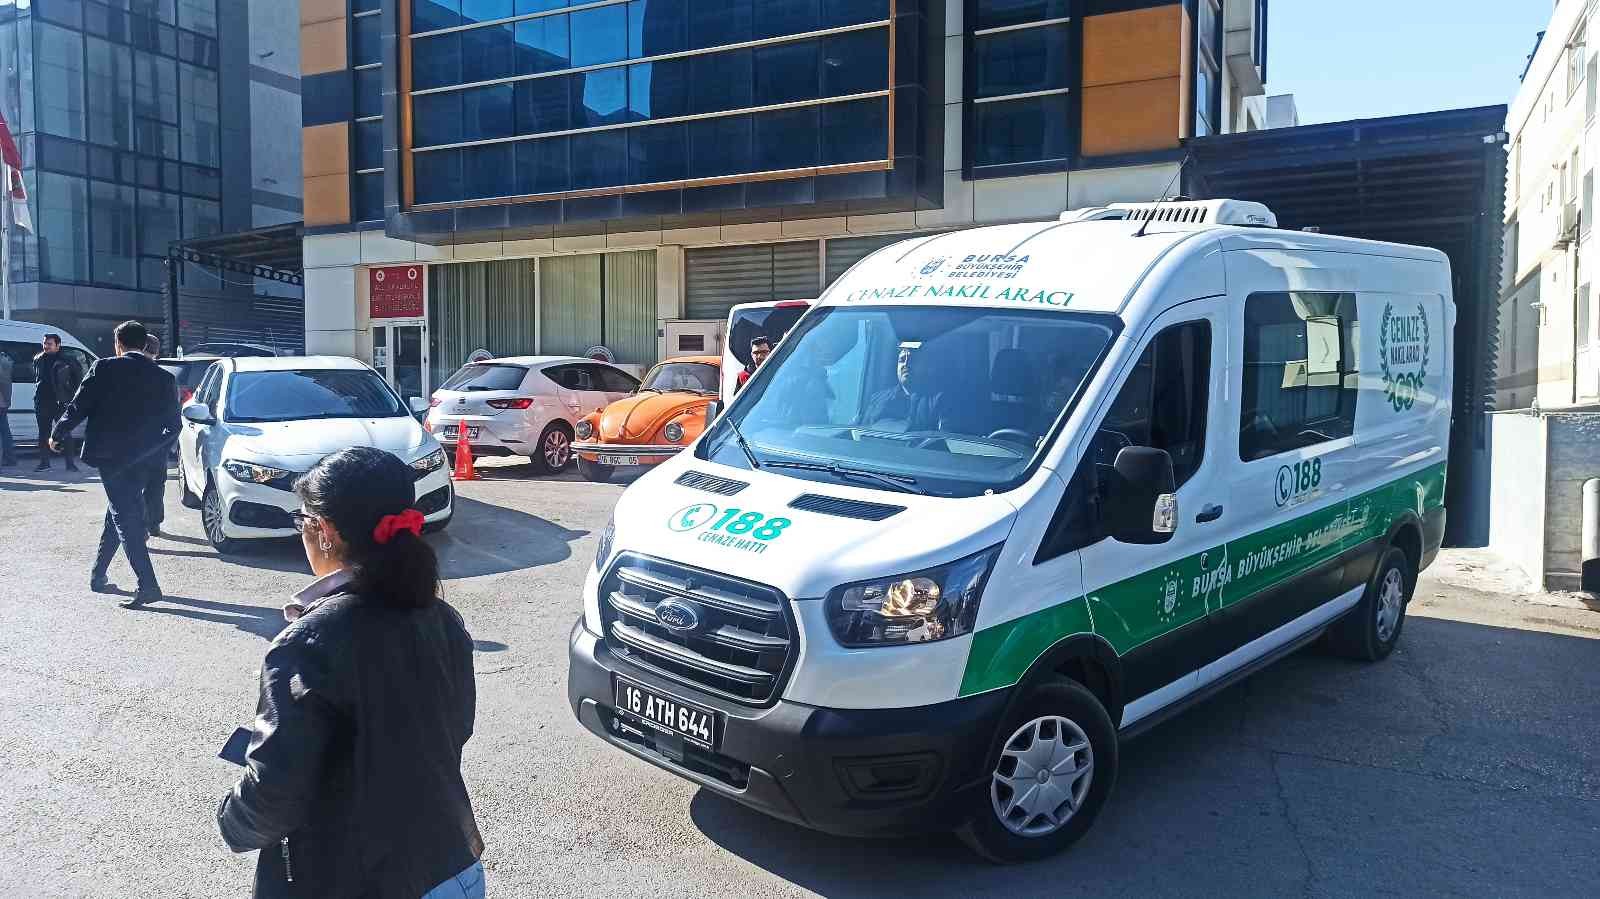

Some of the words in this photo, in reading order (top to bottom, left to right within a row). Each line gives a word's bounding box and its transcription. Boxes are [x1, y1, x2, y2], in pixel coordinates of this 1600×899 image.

[962, 254, 1030, 263] BURSA
[923, 282, 991, 299] NAKİL
[994, 287, 1075, 307] ARACI
[1391, 315, 1420, 343] CENAZE
[1294, 457, 1321, 494] 188
[710, 508, 792, 541] 188
[697, 531, 737, 547] CENAZE
[733, 538, 769, 554] HATTI
[1192, 564, 1232, 598] BURSA
[1237, 534, 1302, 580] BÜYÜKŞEHİR
[661, 607, 687, 625] Ford
[626, 686, 641, 713] 16
[645, 695, 675, 727] ATH
[678, 707, 709, 741] 644
